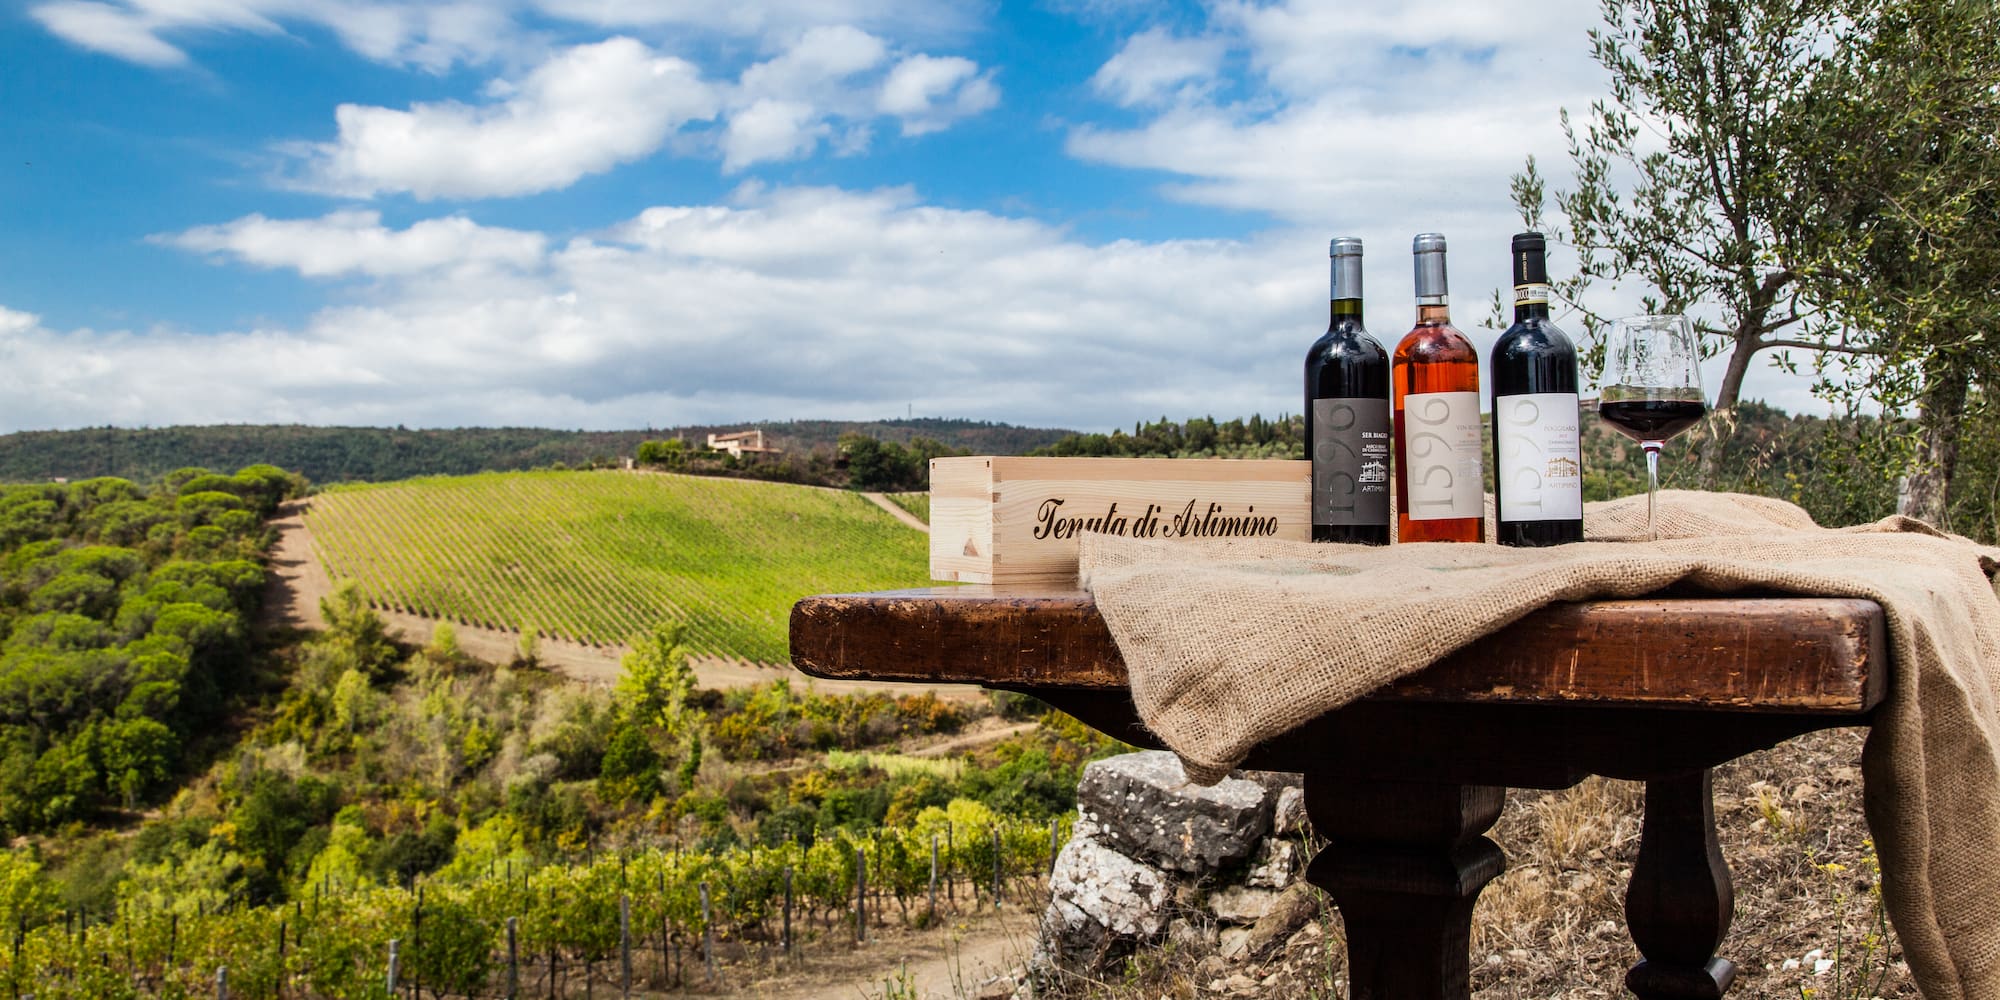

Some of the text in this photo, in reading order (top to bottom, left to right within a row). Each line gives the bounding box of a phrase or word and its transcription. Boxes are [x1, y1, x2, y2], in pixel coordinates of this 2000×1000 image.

[1316, 403, 1356, 518] 1596
[1408, 398, 1454, 512] 1596
[1504, 399, 1542, 513] 1596
[1033, 498, 1279, 539] Tenuta di Artimino
